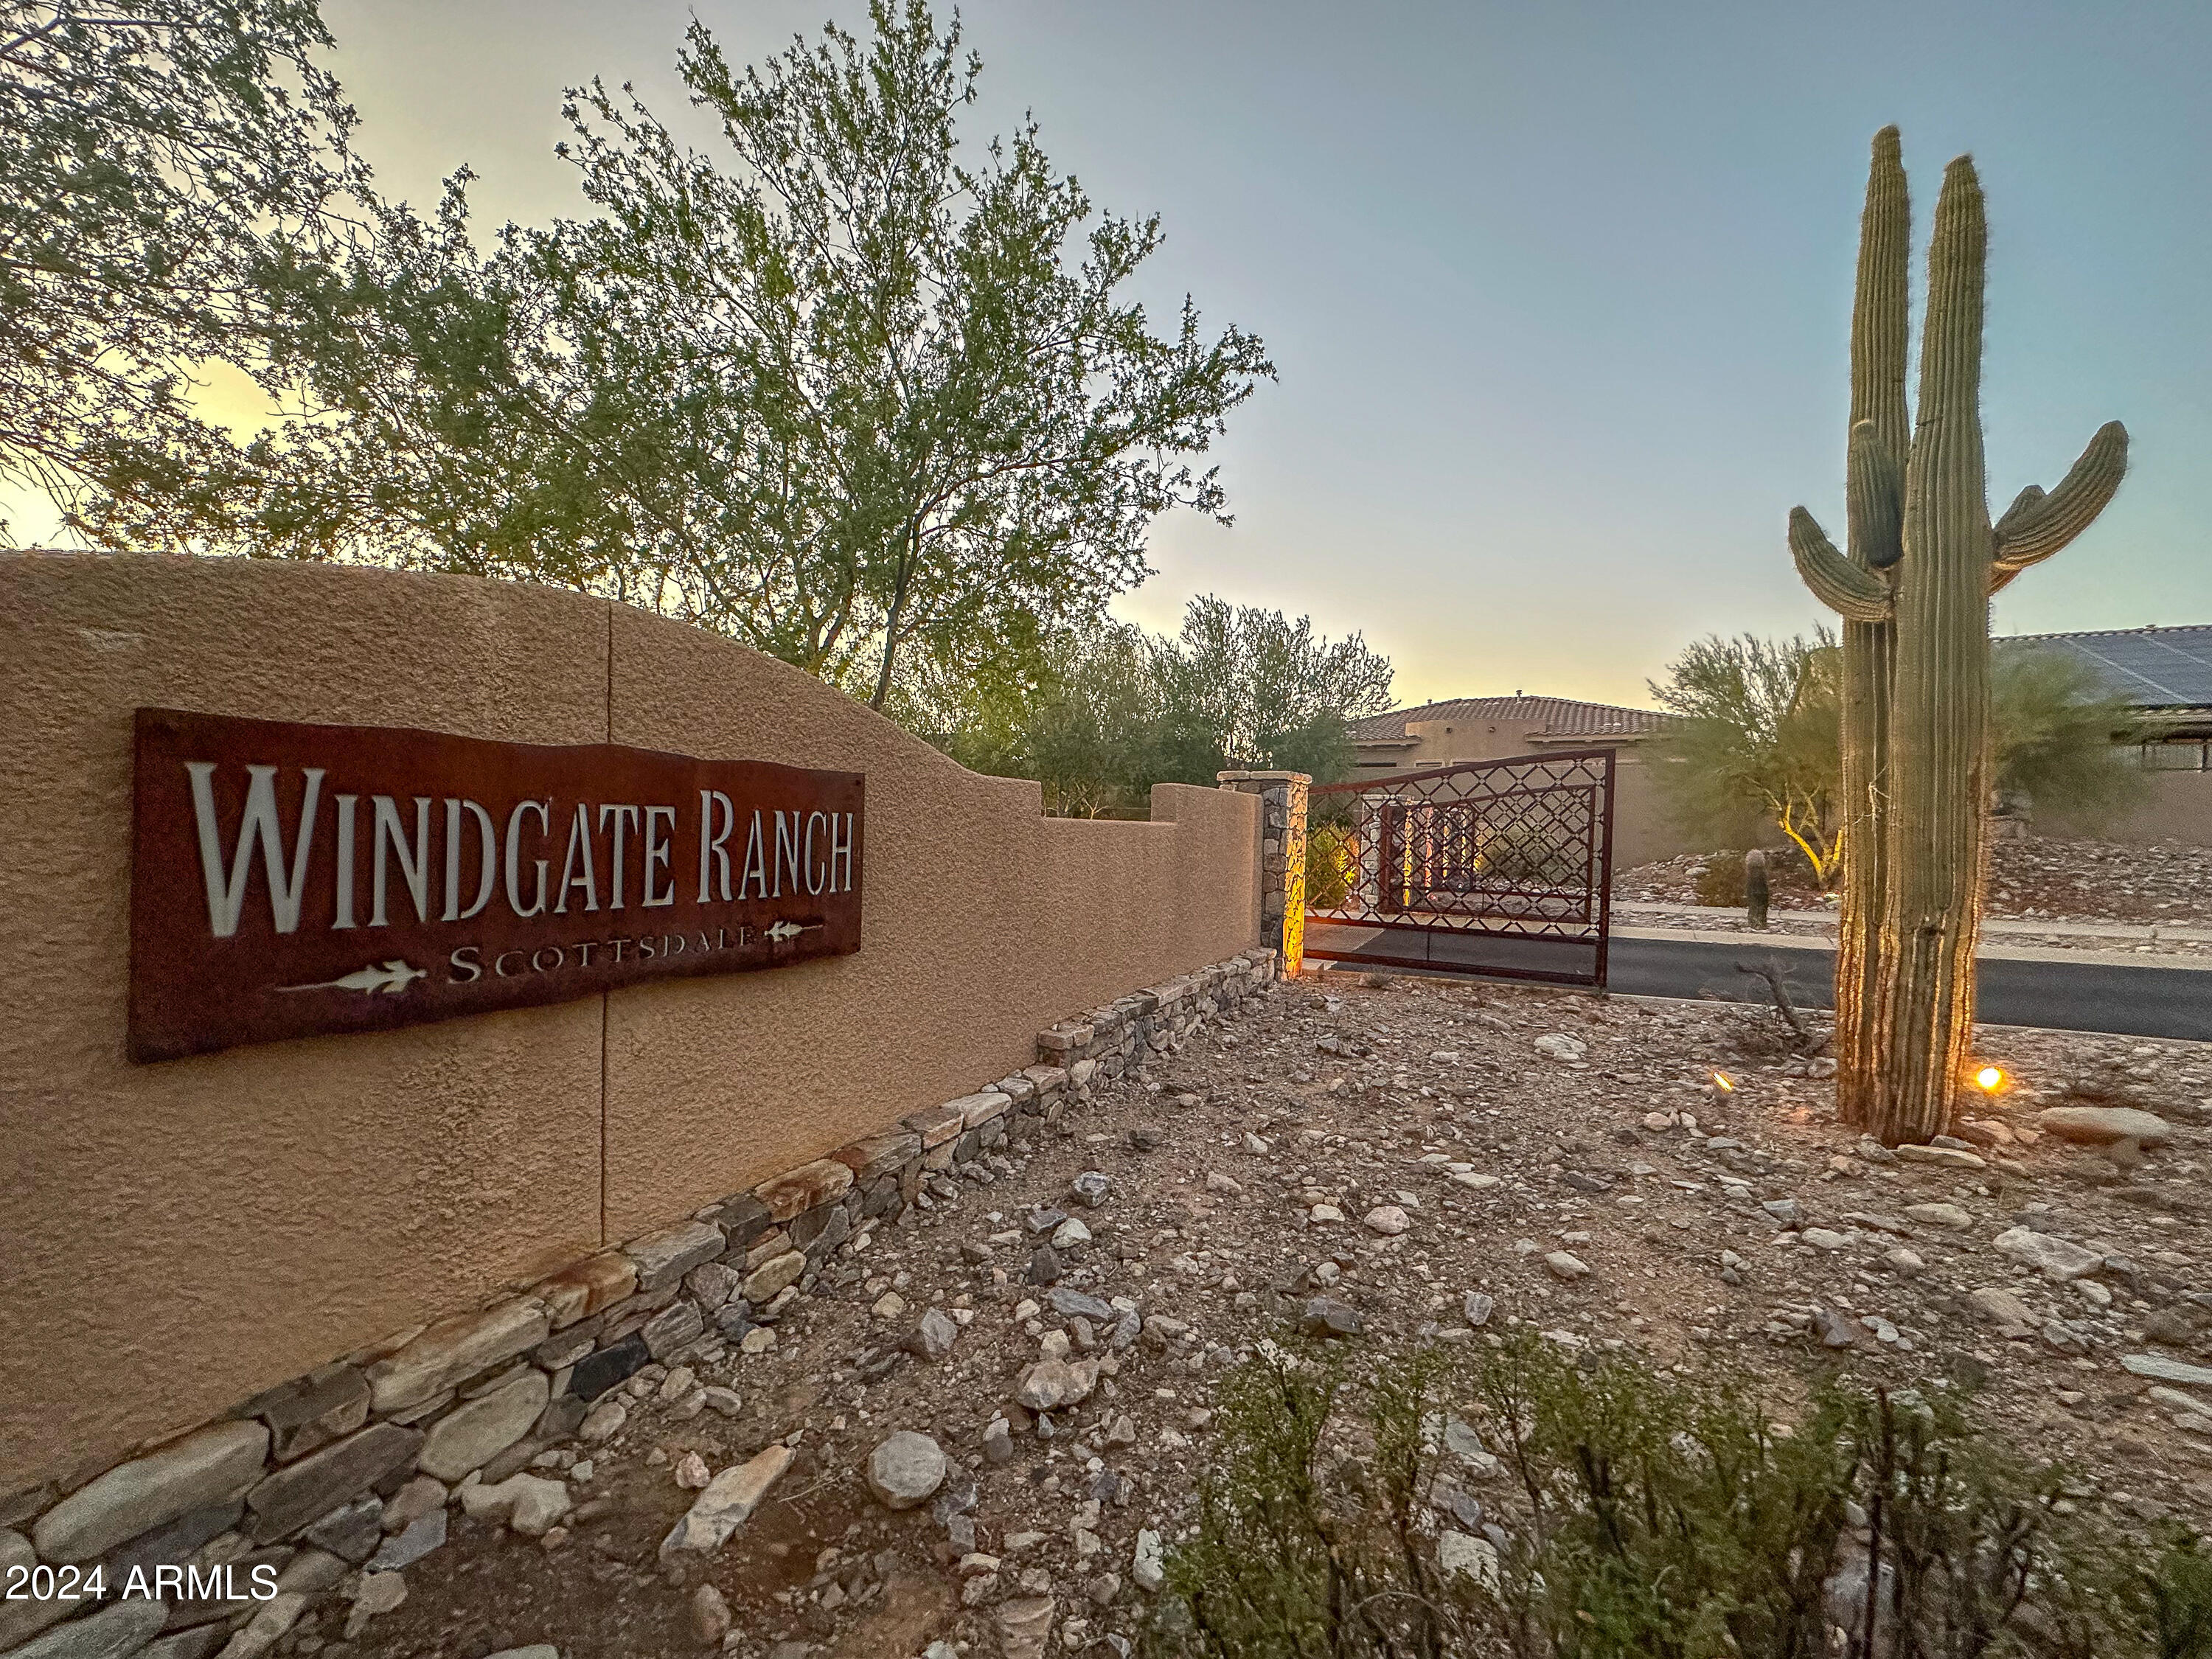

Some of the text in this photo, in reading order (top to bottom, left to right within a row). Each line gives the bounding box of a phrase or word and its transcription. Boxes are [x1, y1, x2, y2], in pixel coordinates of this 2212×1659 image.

[184, 761, 854, 938] WINDGATE RANCH
[447, 926, 755, 984] SCOTTSDALE
